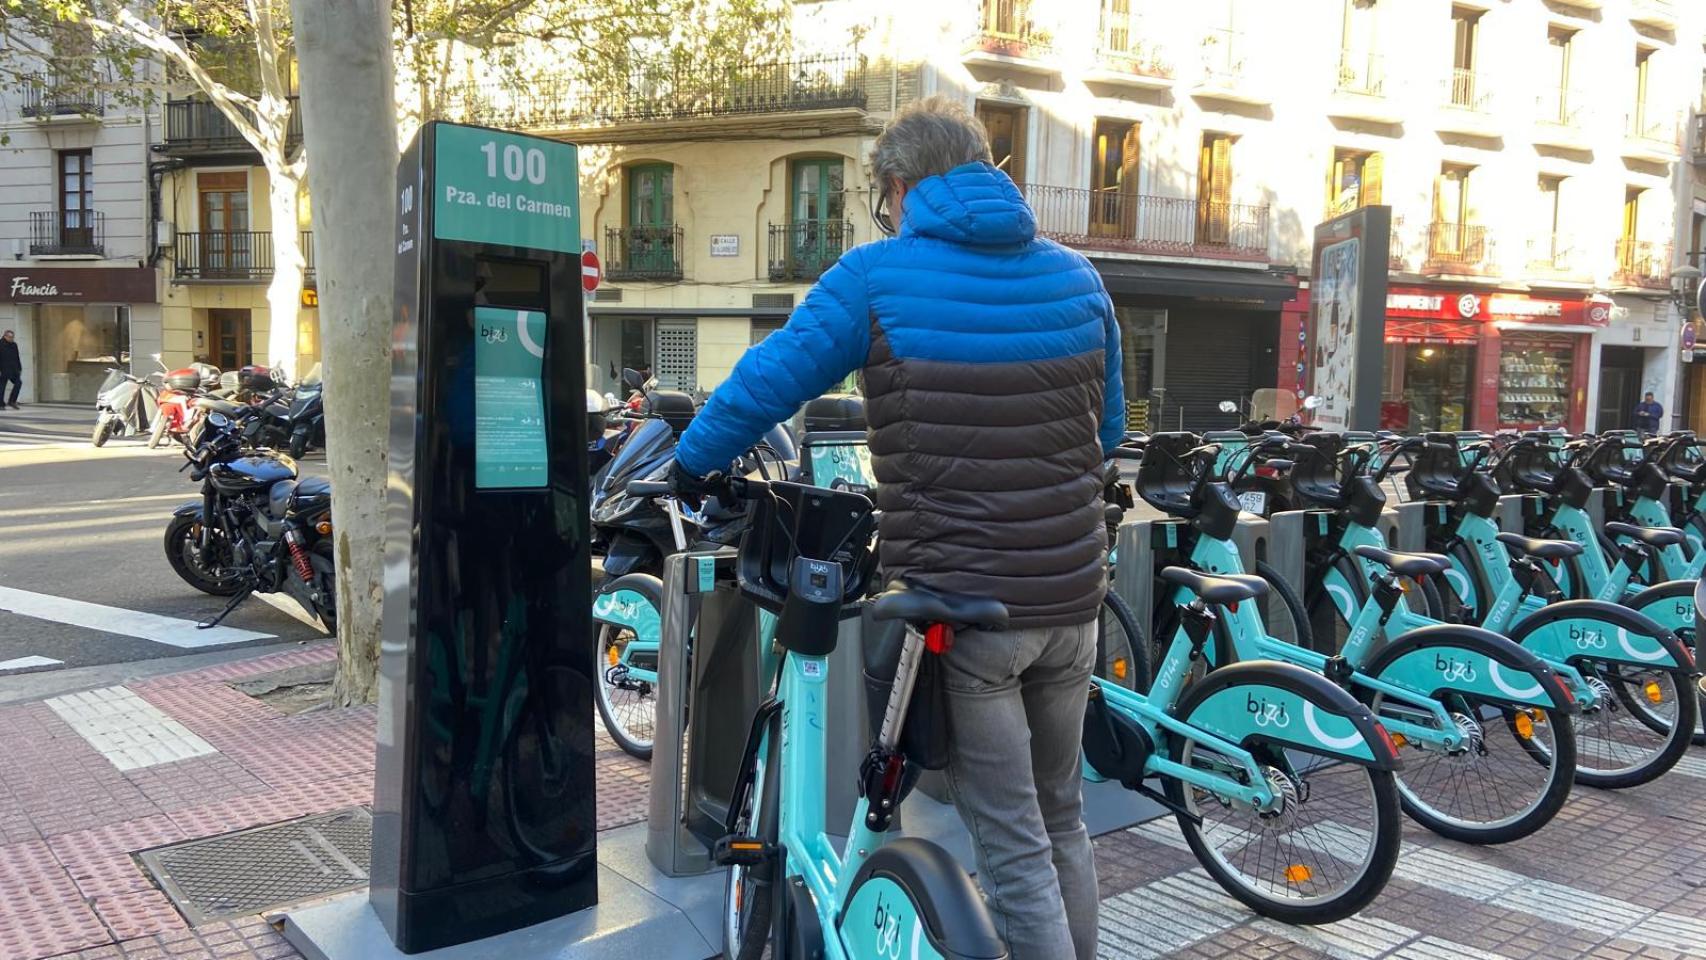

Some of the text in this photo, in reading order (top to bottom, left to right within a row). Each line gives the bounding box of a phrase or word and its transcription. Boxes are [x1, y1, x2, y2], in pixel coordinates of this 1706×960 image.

[480, 141, 545, 185] 100
[401, 184, 413, 216] 100
[446, 185, 571, 218] Pza. del Carmen
[11, 276, 58, 298] Francia
[481, 323, 508, 344] bizi
[1493, 600, 1510, 623] 0743
[1351, 625, 1368, 647] 1251
[1569, 624, 1607, 649] bizi
[1160, 657, 1179, 689] 0744
[1435, 653, 1476, 682] bizi
[1247, 692, 1289, 727] bizi
[873, 890, 901, 960] bizi
